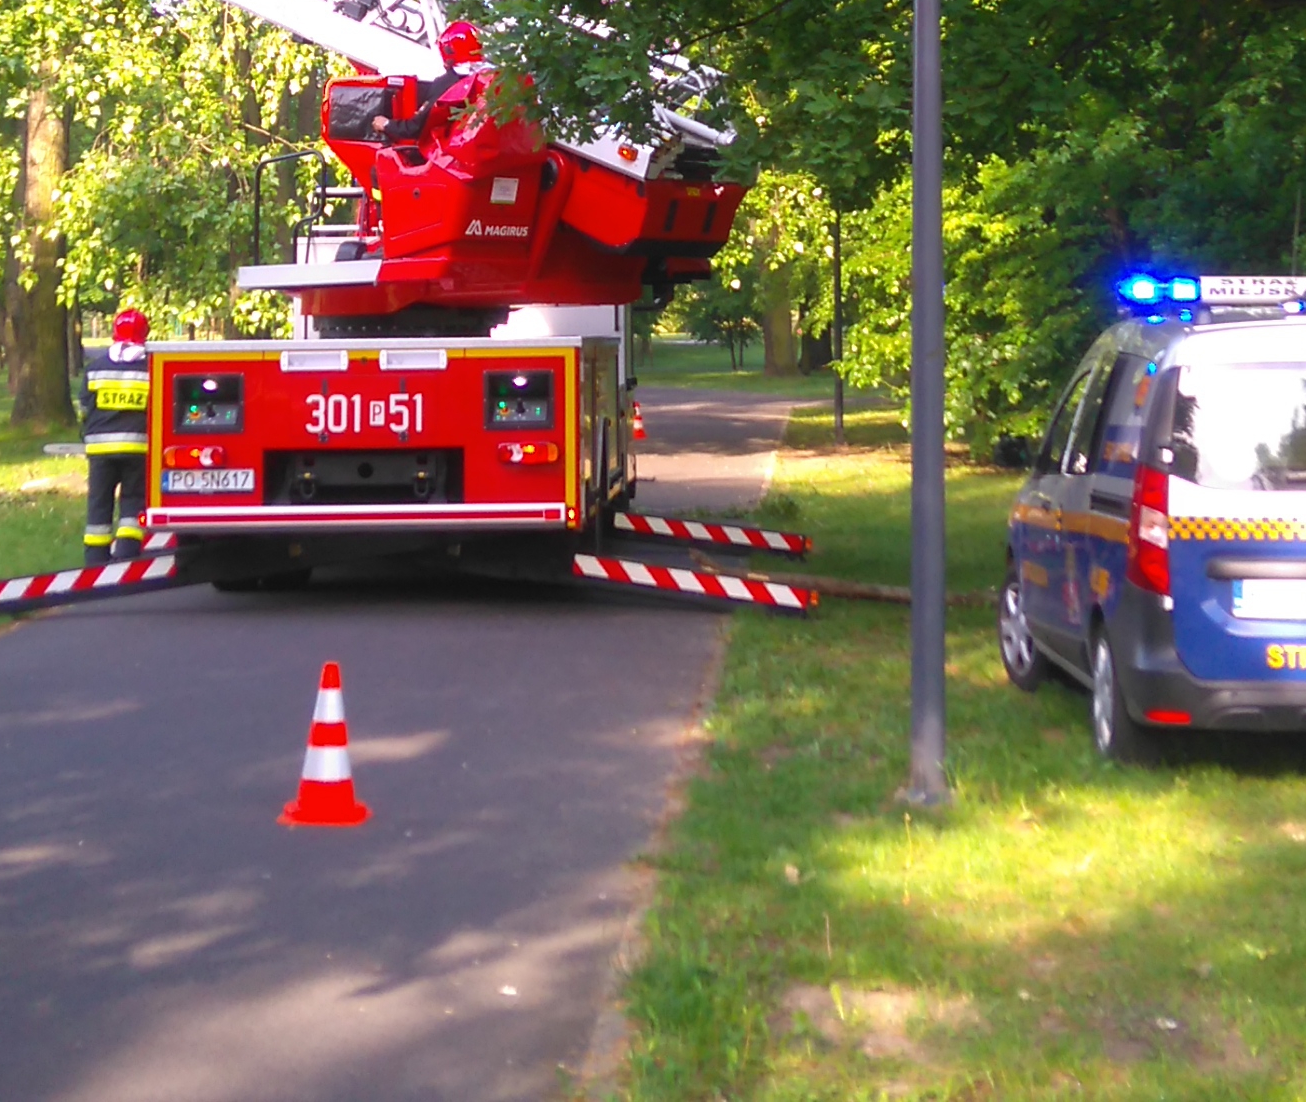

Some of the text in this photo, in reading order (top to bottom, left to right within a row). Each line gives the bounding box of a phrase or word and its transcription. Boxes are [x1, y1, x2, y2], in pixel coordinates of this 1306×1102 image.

[484, 225, 529, 237] MAGIRUS
[305, 393, 423, 434] 301 P 51
[171, 471, 251, 488] PO 5N617
